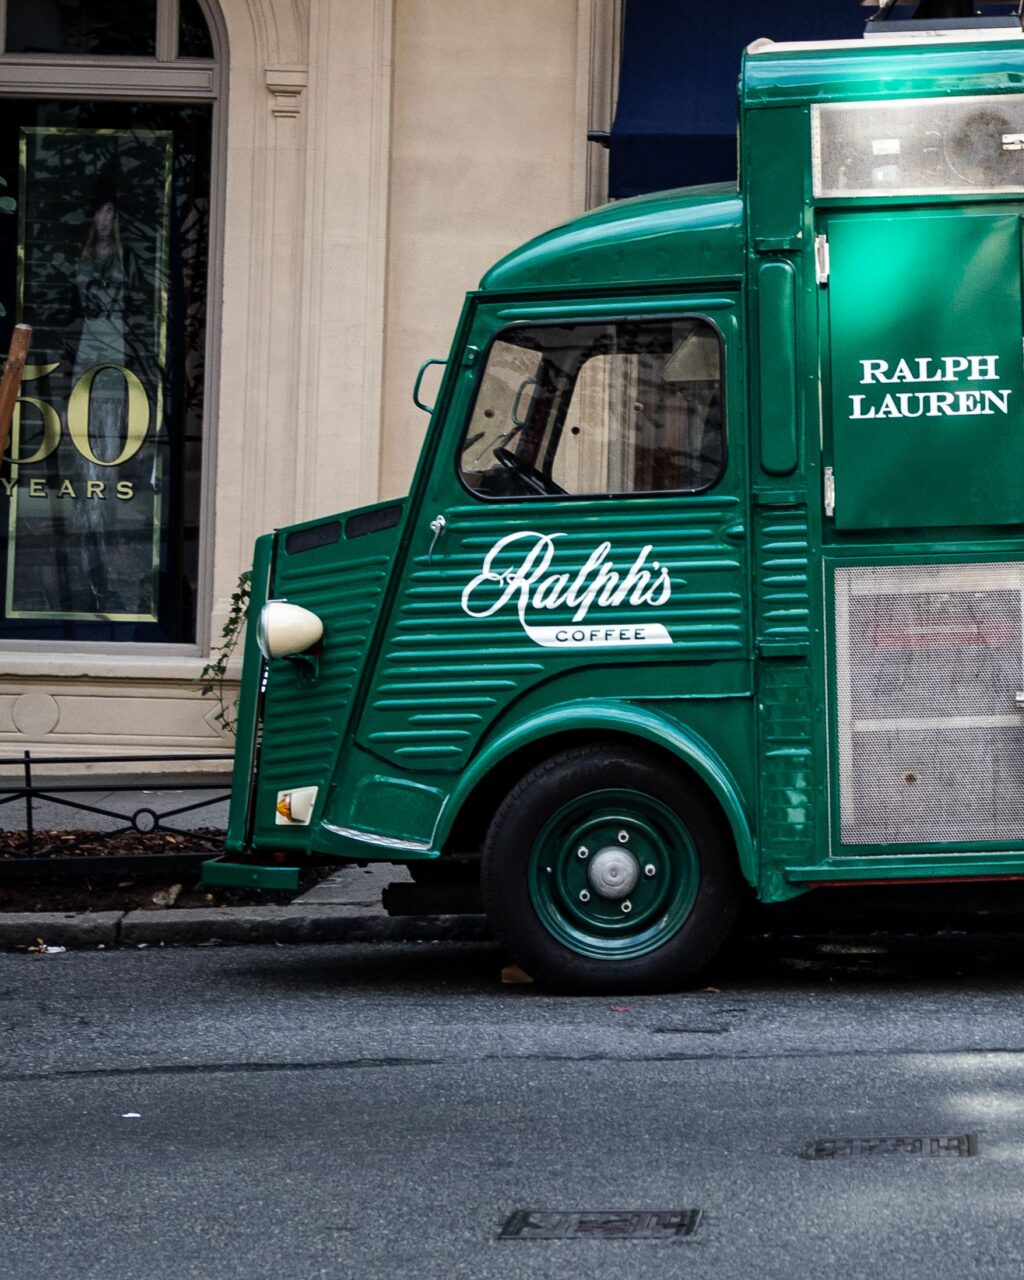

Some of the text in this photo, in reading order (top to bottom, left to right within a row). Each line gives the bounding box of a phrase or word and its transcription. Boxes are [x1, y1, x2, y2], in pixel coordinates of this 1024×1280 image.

[859, 355, 1000, 384] RALPH
[849, 389, 1012, 419] LAUREN
[0, 478, 135, 500] YEARS
[461, 530, 672, 627] Ralph's
[555, 628, 646, 642] COFFEE
